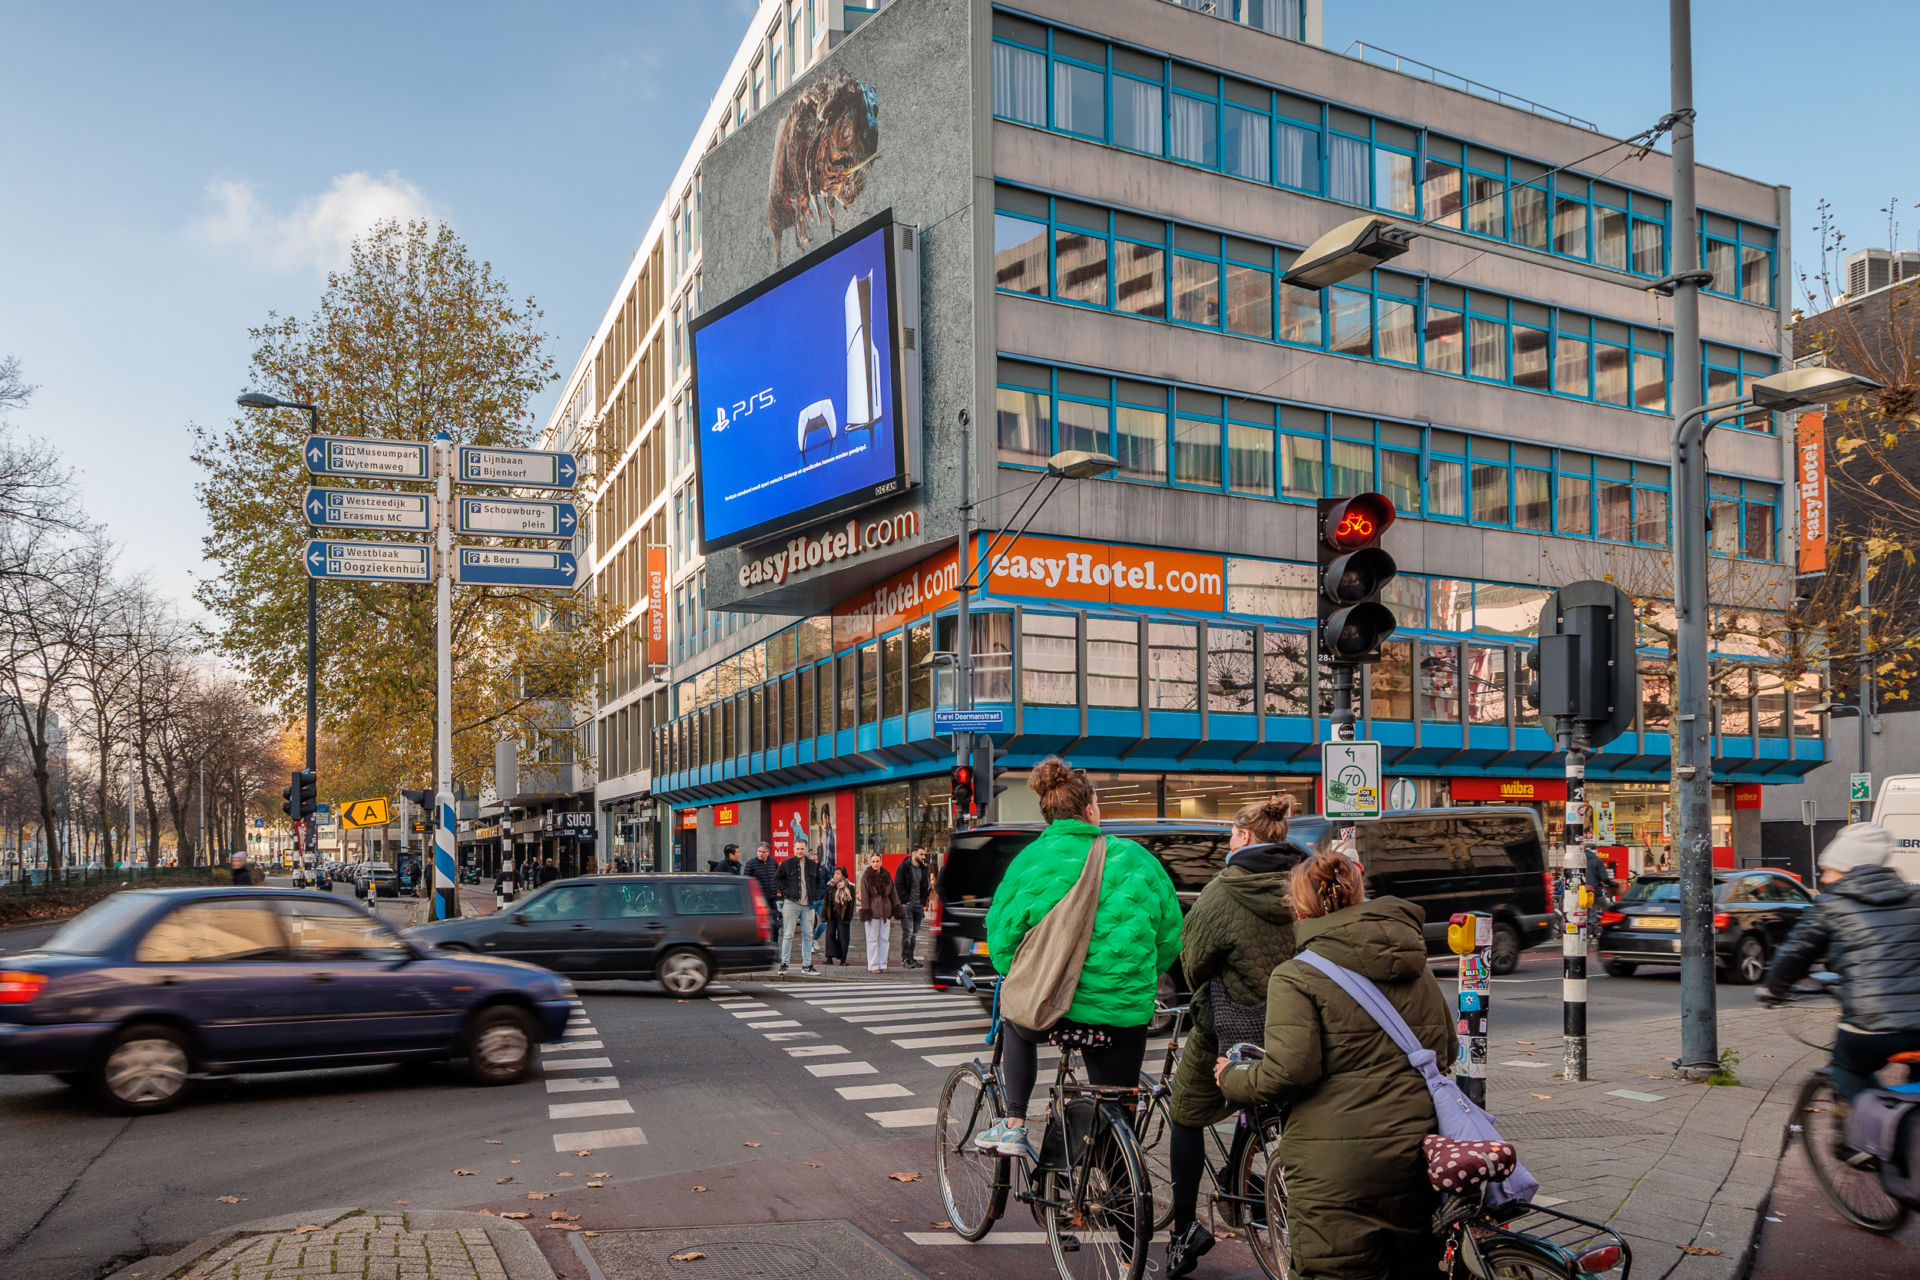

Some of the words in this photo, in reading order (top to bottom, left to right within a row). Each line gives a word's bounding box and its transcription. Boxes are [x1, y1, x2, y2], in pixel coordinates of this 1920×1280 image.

[733, 388, 773, 421] PS5
[357, 447, 418, 460] Museumpark
[483, 454, 523, 466] Lijnbaan
[345, 459, 403, 473] Wytemaweg
[484, 467, 526, 478] Bijenkorf
[875, 481, 897, 495] OCEAN
[1802, 443, 1823, 541] easyHotel
[346, 497, 406, 509] Westzeedijk
[343, 512, 384, 521] Erasmus
[387, 513, 402, 522] MC
[484, 505, 545, 518] Schouwburg-
[522, 519, 545, 530] plein
[347, 548, 399, 559] Westblaak
[739, 510, 915, 588] easyHotel.com
[494, 555, 520, 564] Beurs
[344, 562, 425, 574] Oogziekenhuis
[992, 552, 1220, 595] easyHotel.com
[845, 562, 958, 634] easyHotel.com
[650, 571, 663, 641] easyHotel
[1345, 774, 1360, 786] 70
[1500, 781, 1534, 794] wibra
[364, 806, 377, 820] A
[567, 814, 591, 826] SUGO
